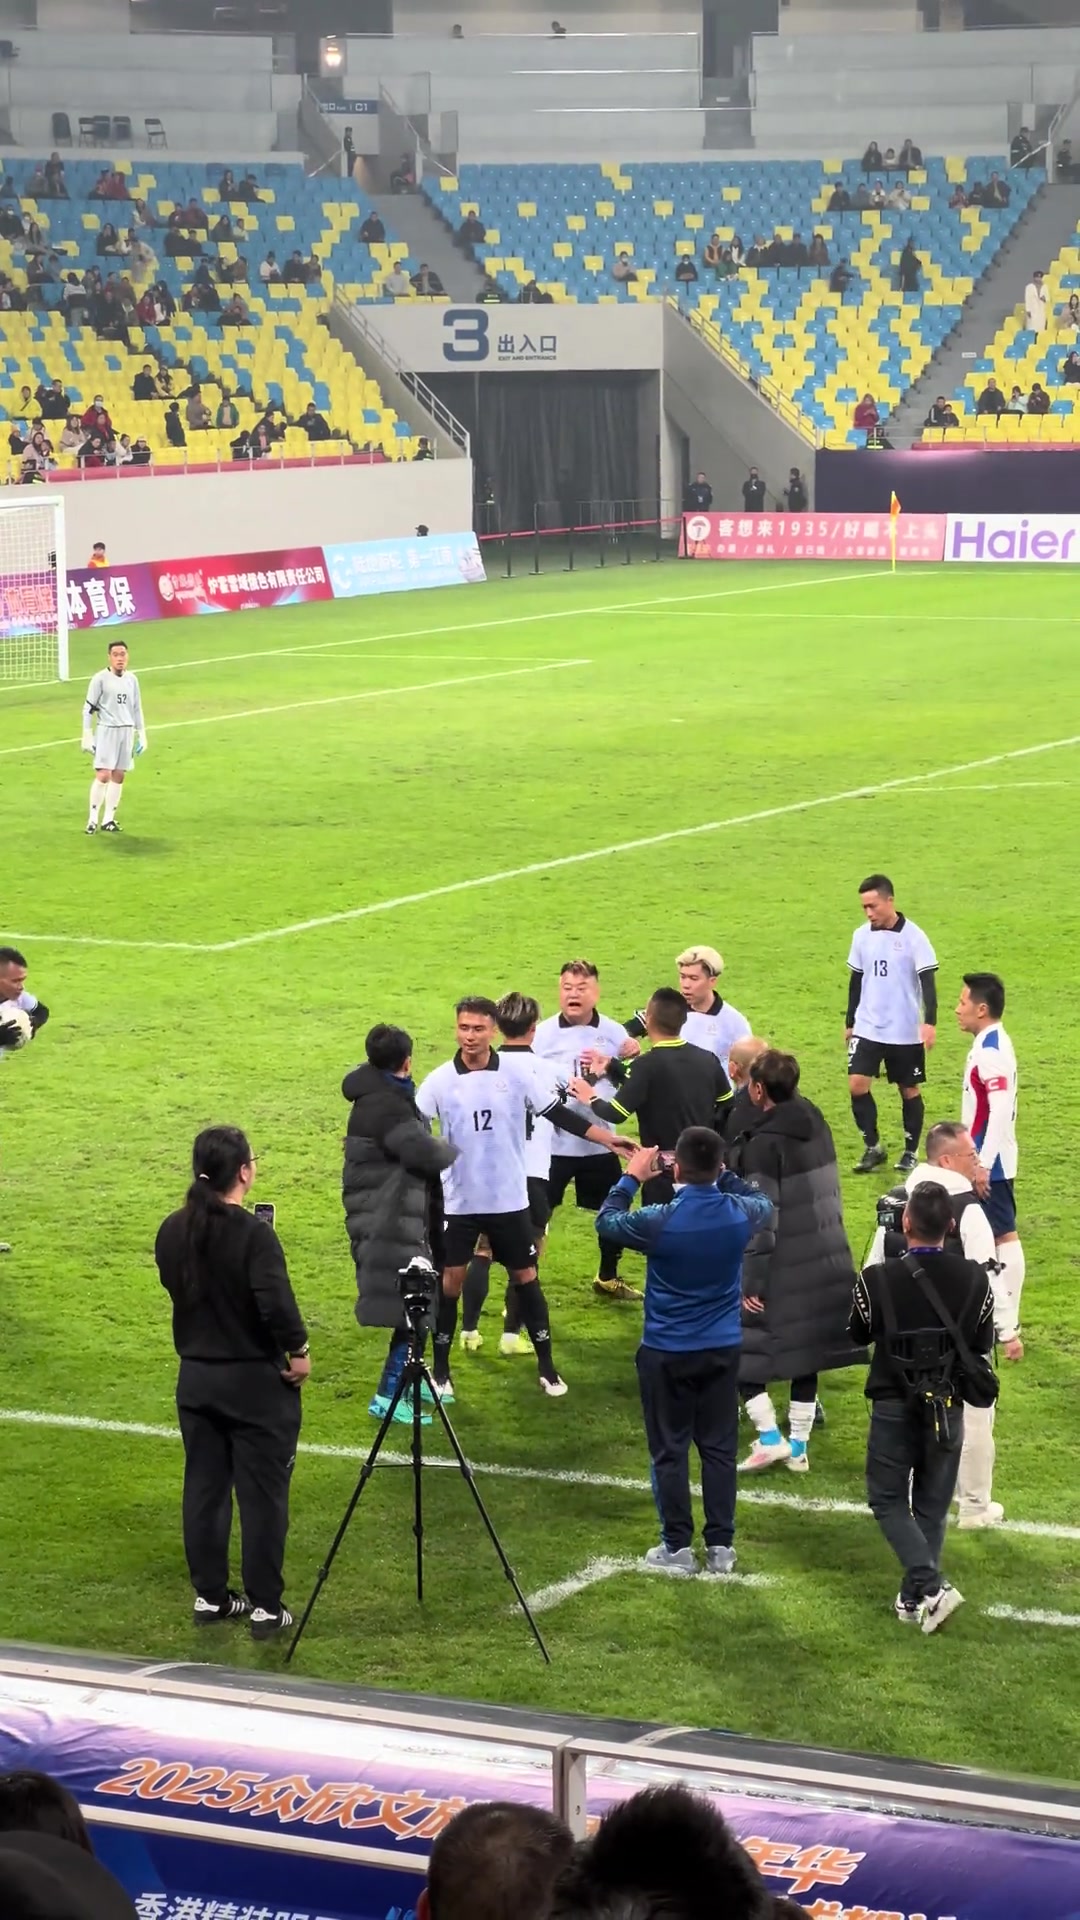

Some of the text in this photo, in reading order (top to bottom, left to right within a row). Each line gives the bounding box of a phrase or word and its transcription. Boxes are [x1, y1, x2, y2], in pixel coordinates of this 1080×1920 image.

[442, 309, 490, 362] 3
[497, 334, 557, 354] 出入口
[952, 519, 1076, 560] Haier
[116, 693, 128, 705] 52
[874, 959, 888, 977] 13
[472, 1109, 493, 1132] 12
